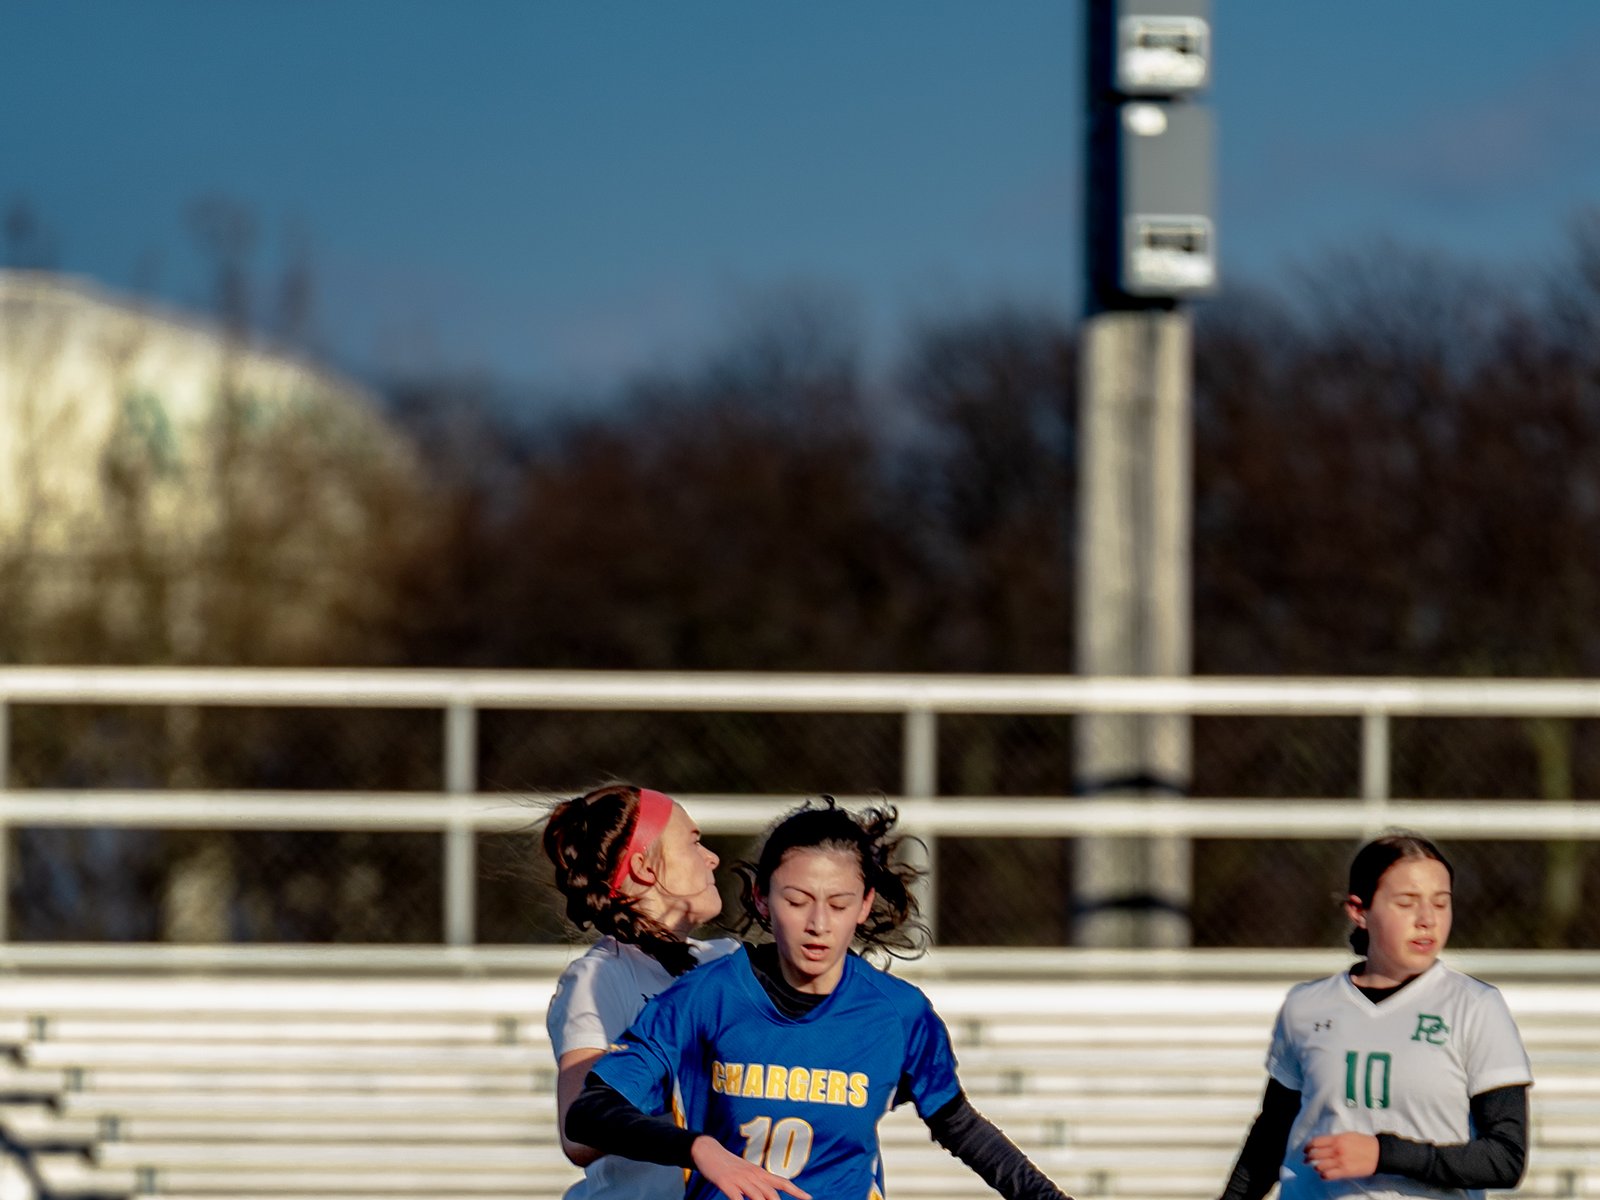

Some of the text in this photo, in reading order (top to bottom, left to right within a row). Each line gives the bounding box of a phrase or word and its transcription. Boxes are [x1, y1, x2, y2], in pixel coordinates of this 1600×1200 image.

[712, 1060, 870, 1109] CHARGERS
[1344, 1051, 1392, 1109] 10
[739, 1115, 814, 1180] 10
